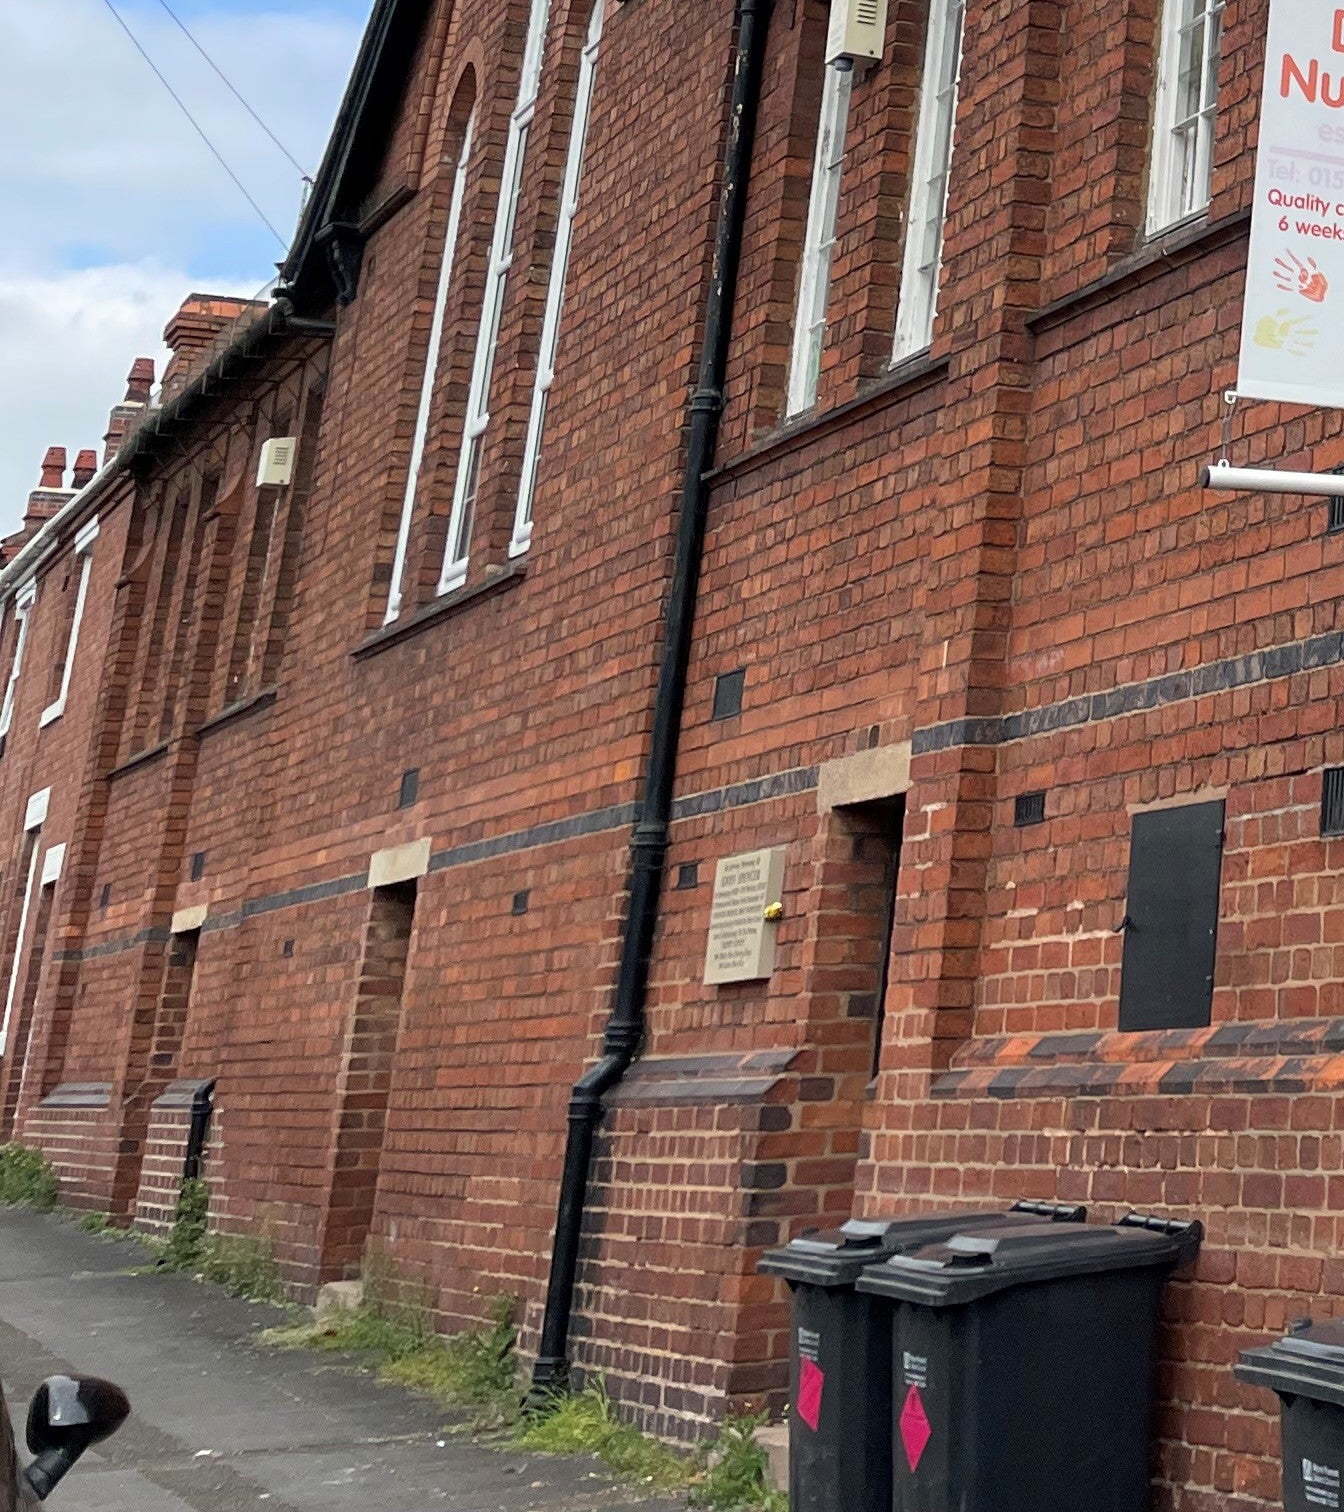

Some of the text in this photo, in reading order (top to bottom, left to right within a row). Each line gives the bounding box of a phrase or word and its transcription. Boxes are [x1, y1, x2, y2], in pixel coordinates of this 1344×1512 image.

[1267, 159, 1299, 184] Tel:
[1267, 188, 1331, 218] Quality
[1278, 215, 1289, 232] 6
